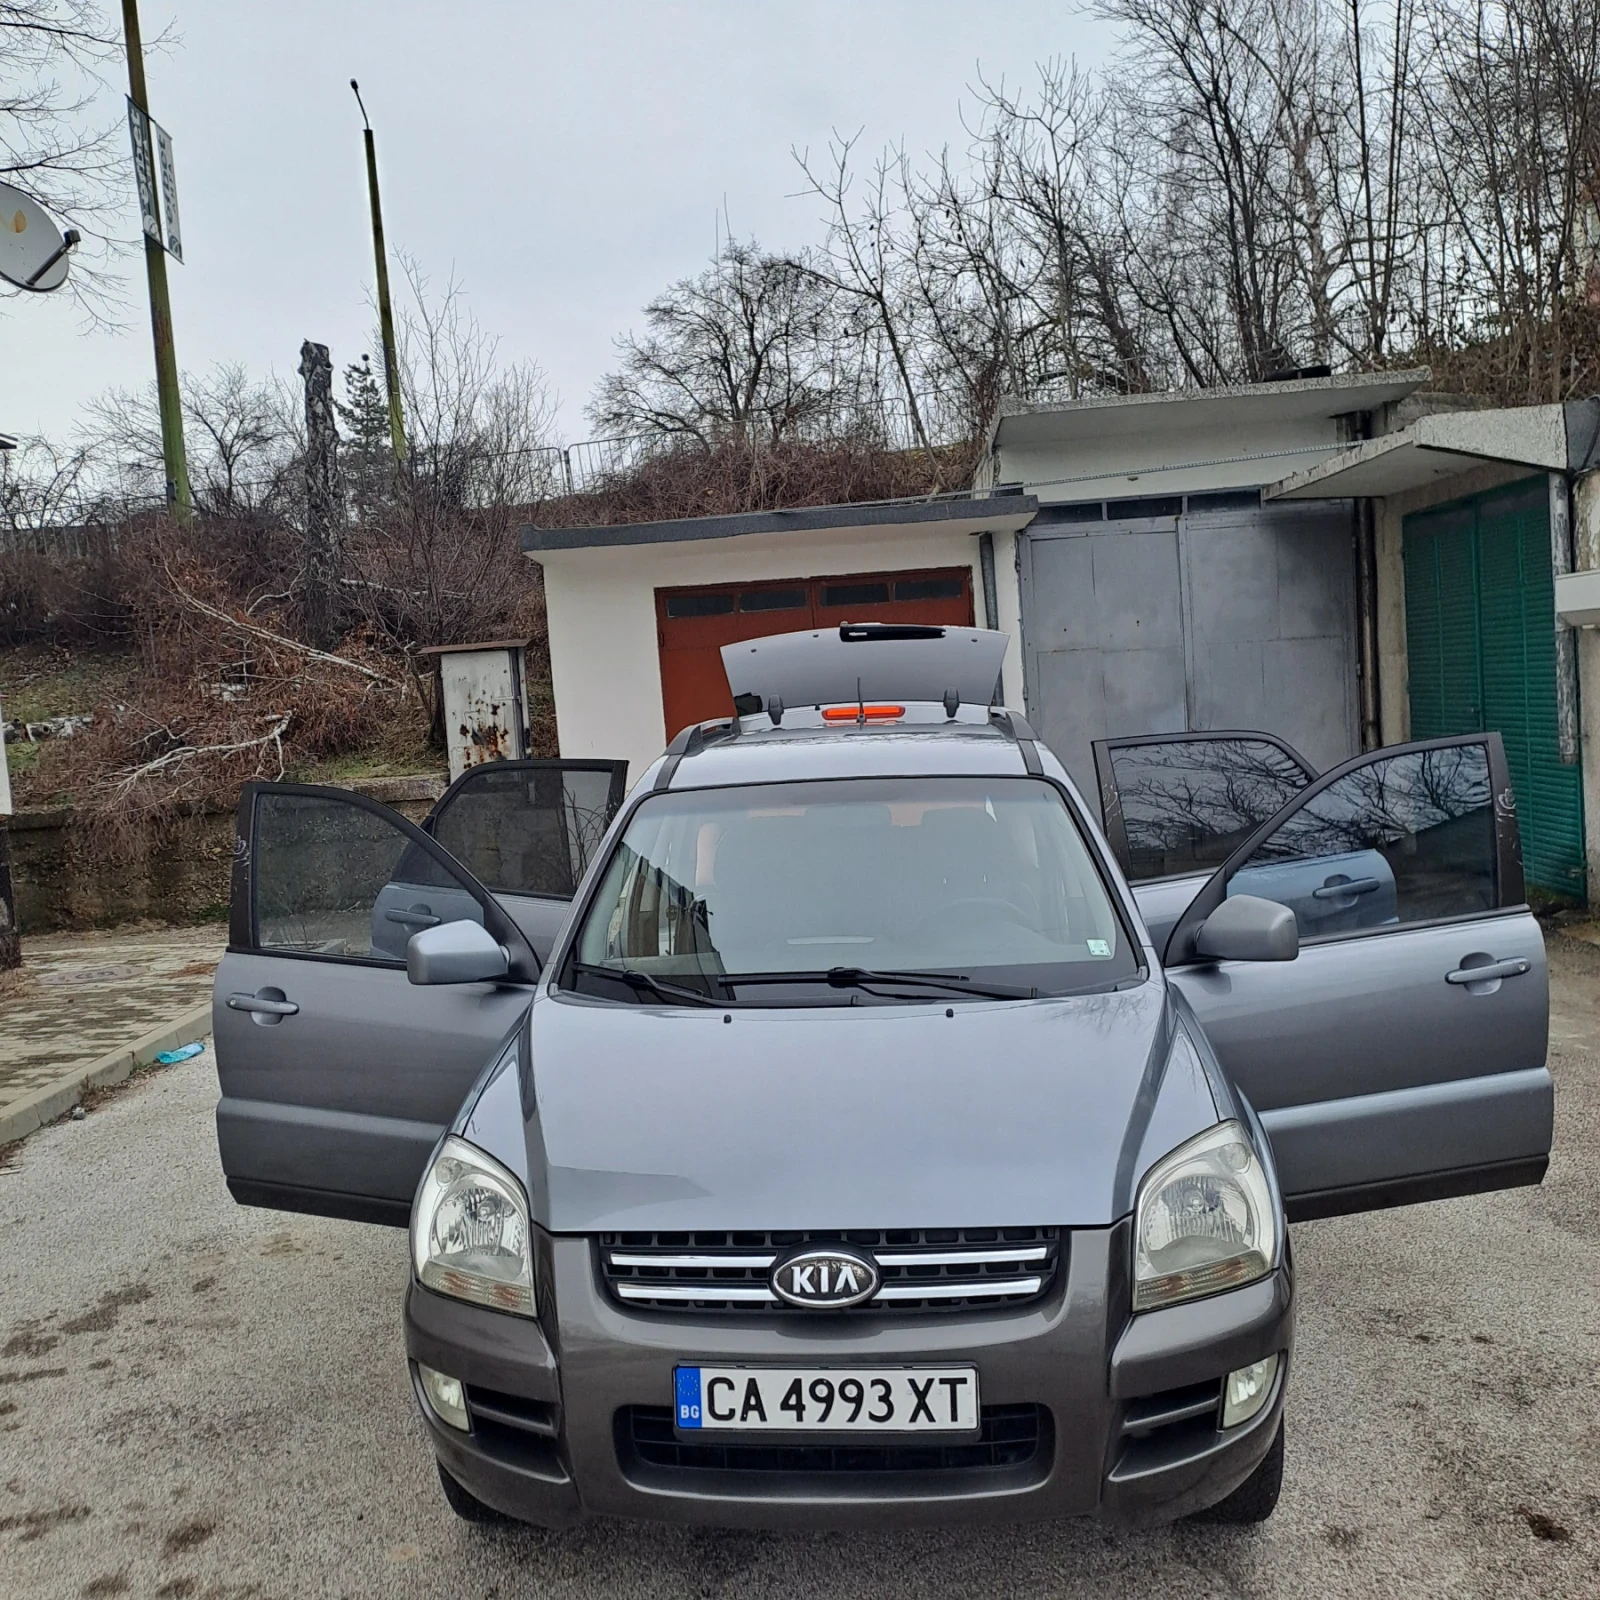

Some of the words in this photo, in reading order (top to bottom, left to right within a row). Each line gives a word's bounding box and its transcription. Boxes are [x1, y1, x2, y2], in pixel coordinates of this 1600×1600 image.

[791, 1266, 859, 1293] KIA
[680, 1405, 700, 1419] BG
[707, 1377, 767, 1422] CA
[779, 1377, 895, 1423] 4993
[907, 1377, 968, 1423] XT
